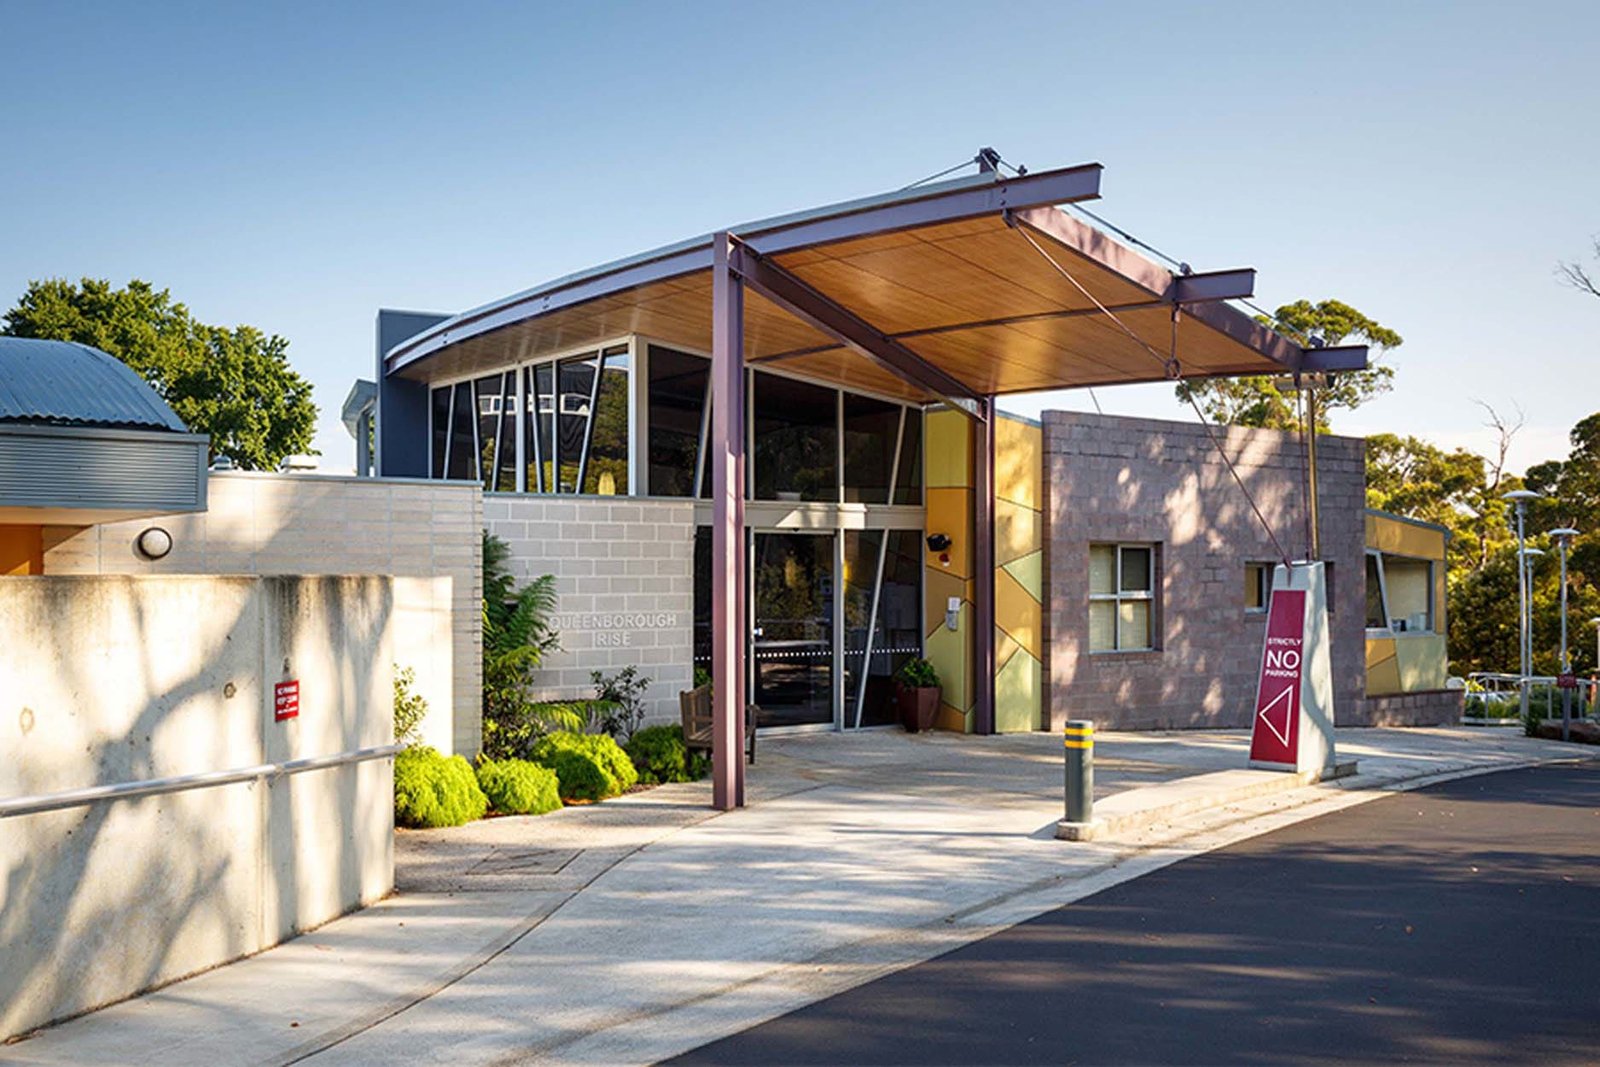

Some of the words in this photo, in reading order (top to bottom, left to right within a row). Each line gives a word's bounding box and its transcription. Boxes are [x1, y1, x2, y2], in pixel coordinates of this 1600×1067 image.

[549, 613, 677, 629] QUEENBOROUGH
[596, 631, 632, 646] RISE
[1268, 637, 1302, 646] STRICTLY
[1266, 650, 1300, 669] NO
[1264, 669, 1299, 678] PARKING
